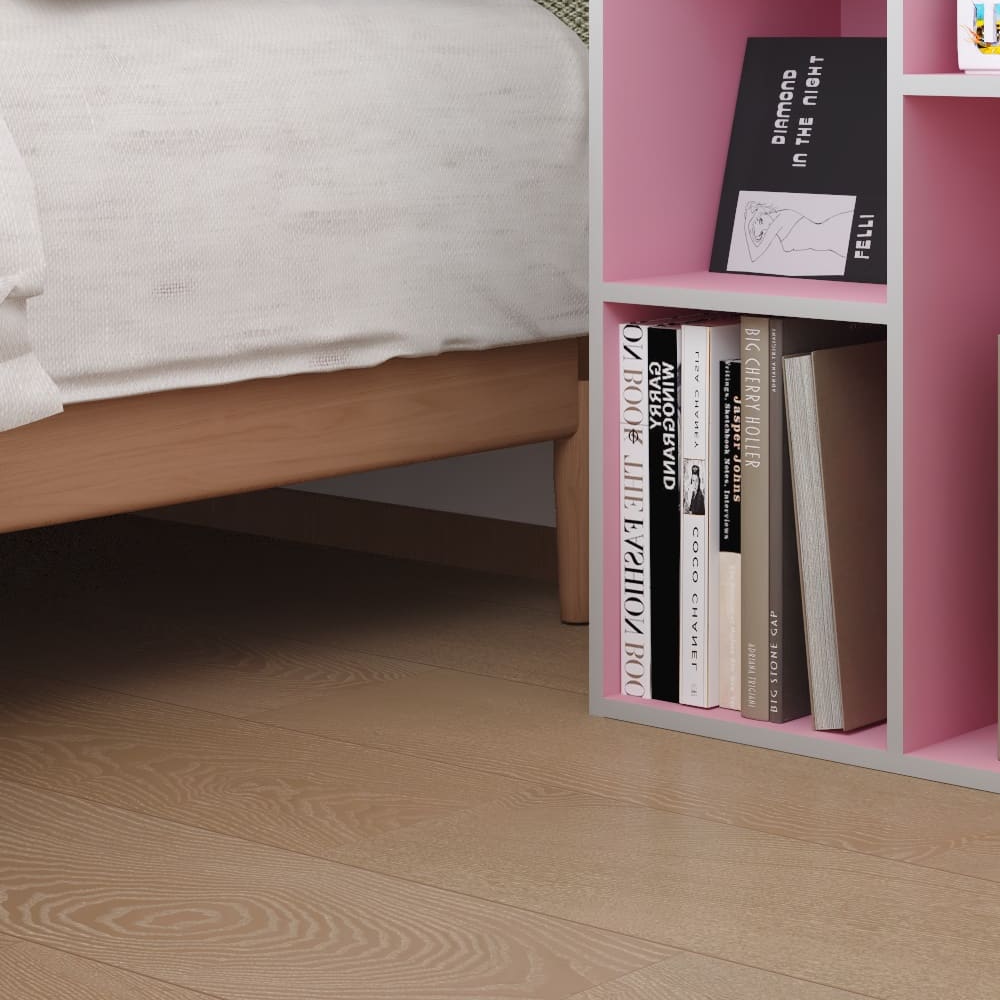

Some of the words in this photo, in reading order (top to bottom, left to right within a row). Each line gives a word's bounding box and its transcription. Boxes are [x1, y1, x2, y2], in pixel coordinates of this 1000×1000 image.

[802, 55, 824, 106] NIGHT
[771, 69, 797, 145] DIAMOND
[795, 117, 814, 146] THE
[854, 214, 875, 260] FELLI
[744, 328, 761, 352] BIG
[744, 358, 761, 411] CHERRY
[731, 395, 742, 449] Jasper
[744, 416, 761, 468] HOLLER
[732, 454, 742, 503] Johns
